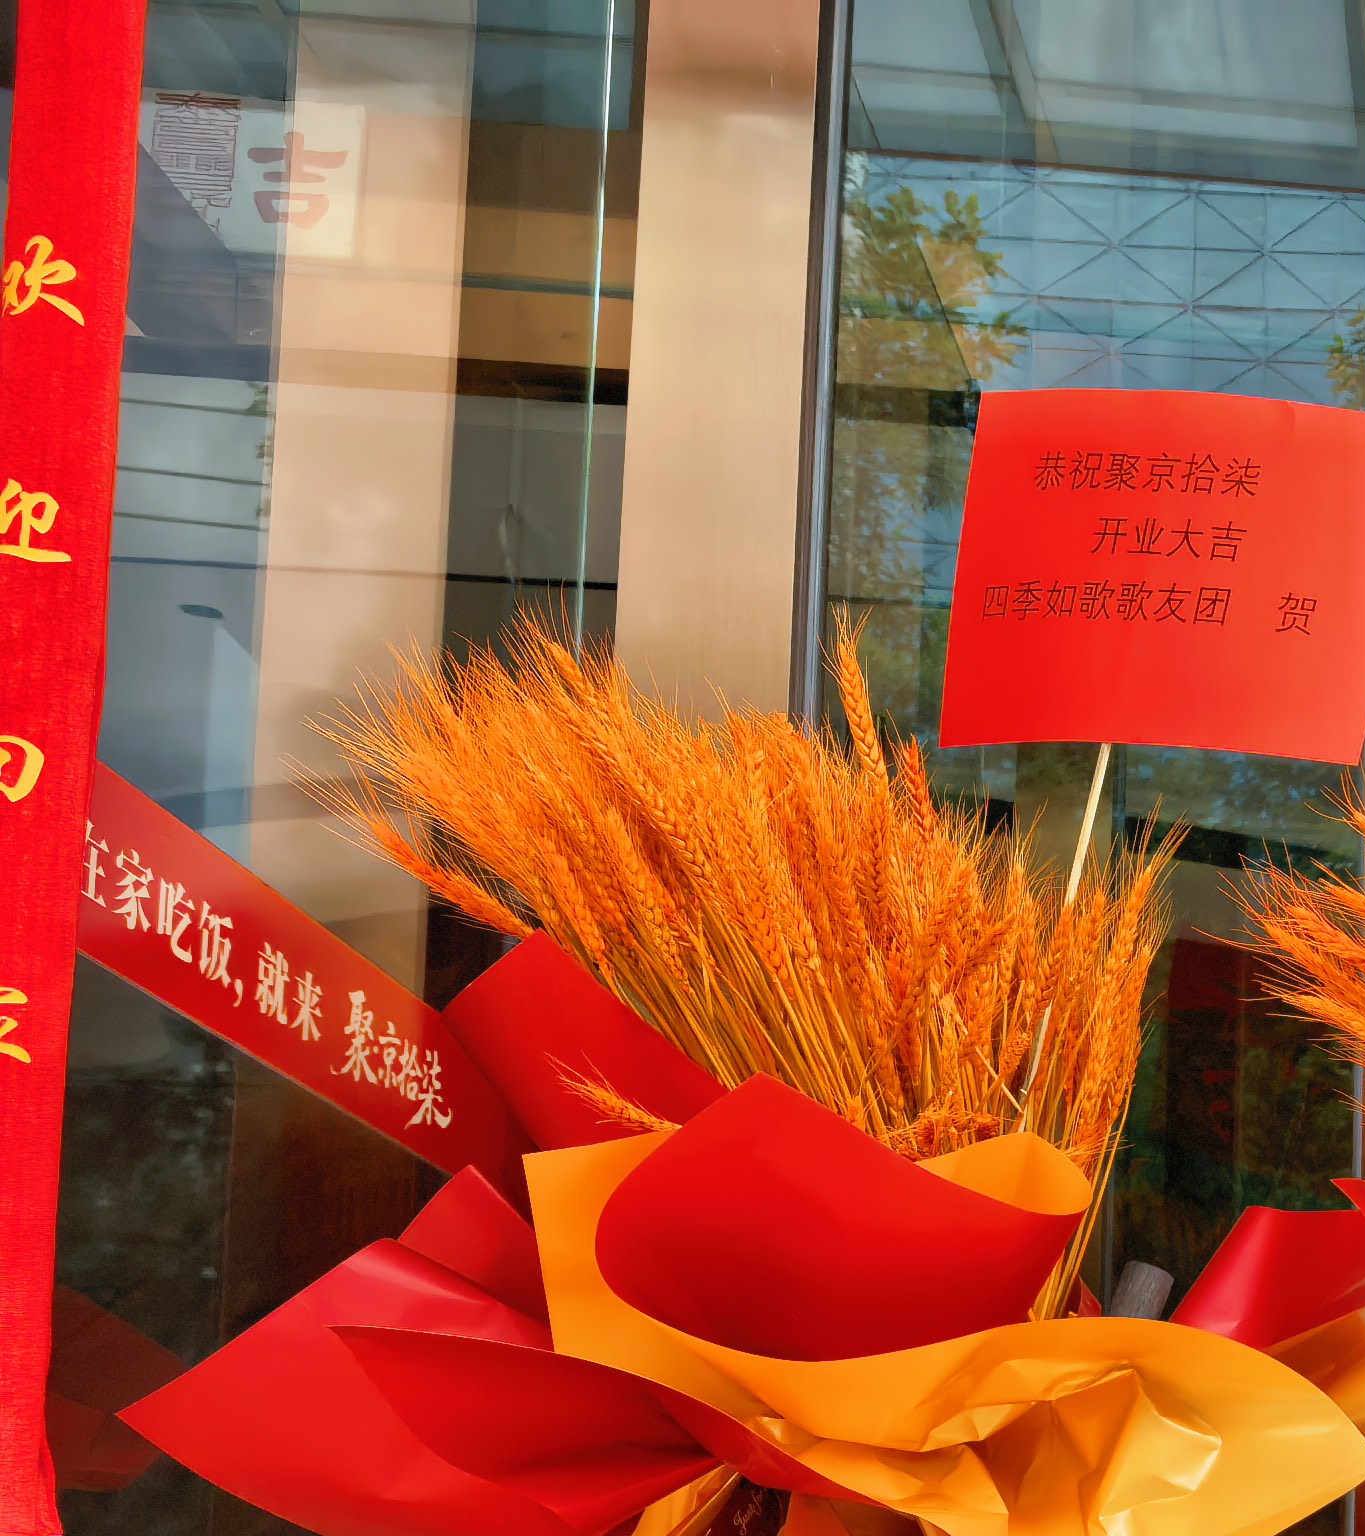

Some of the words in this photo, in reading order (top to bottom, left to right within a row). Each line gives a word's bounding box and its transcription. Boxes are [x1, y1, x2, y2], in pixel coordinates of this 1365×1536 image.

[1034, 452, 1261, 497] 恭祝聚京拾柒
[1091, 518, 1247, 561] 开业大吉
[982, 580, 1232, 625] 四季如歌歌友团
[1276, 593, 1318, 635] 贺
